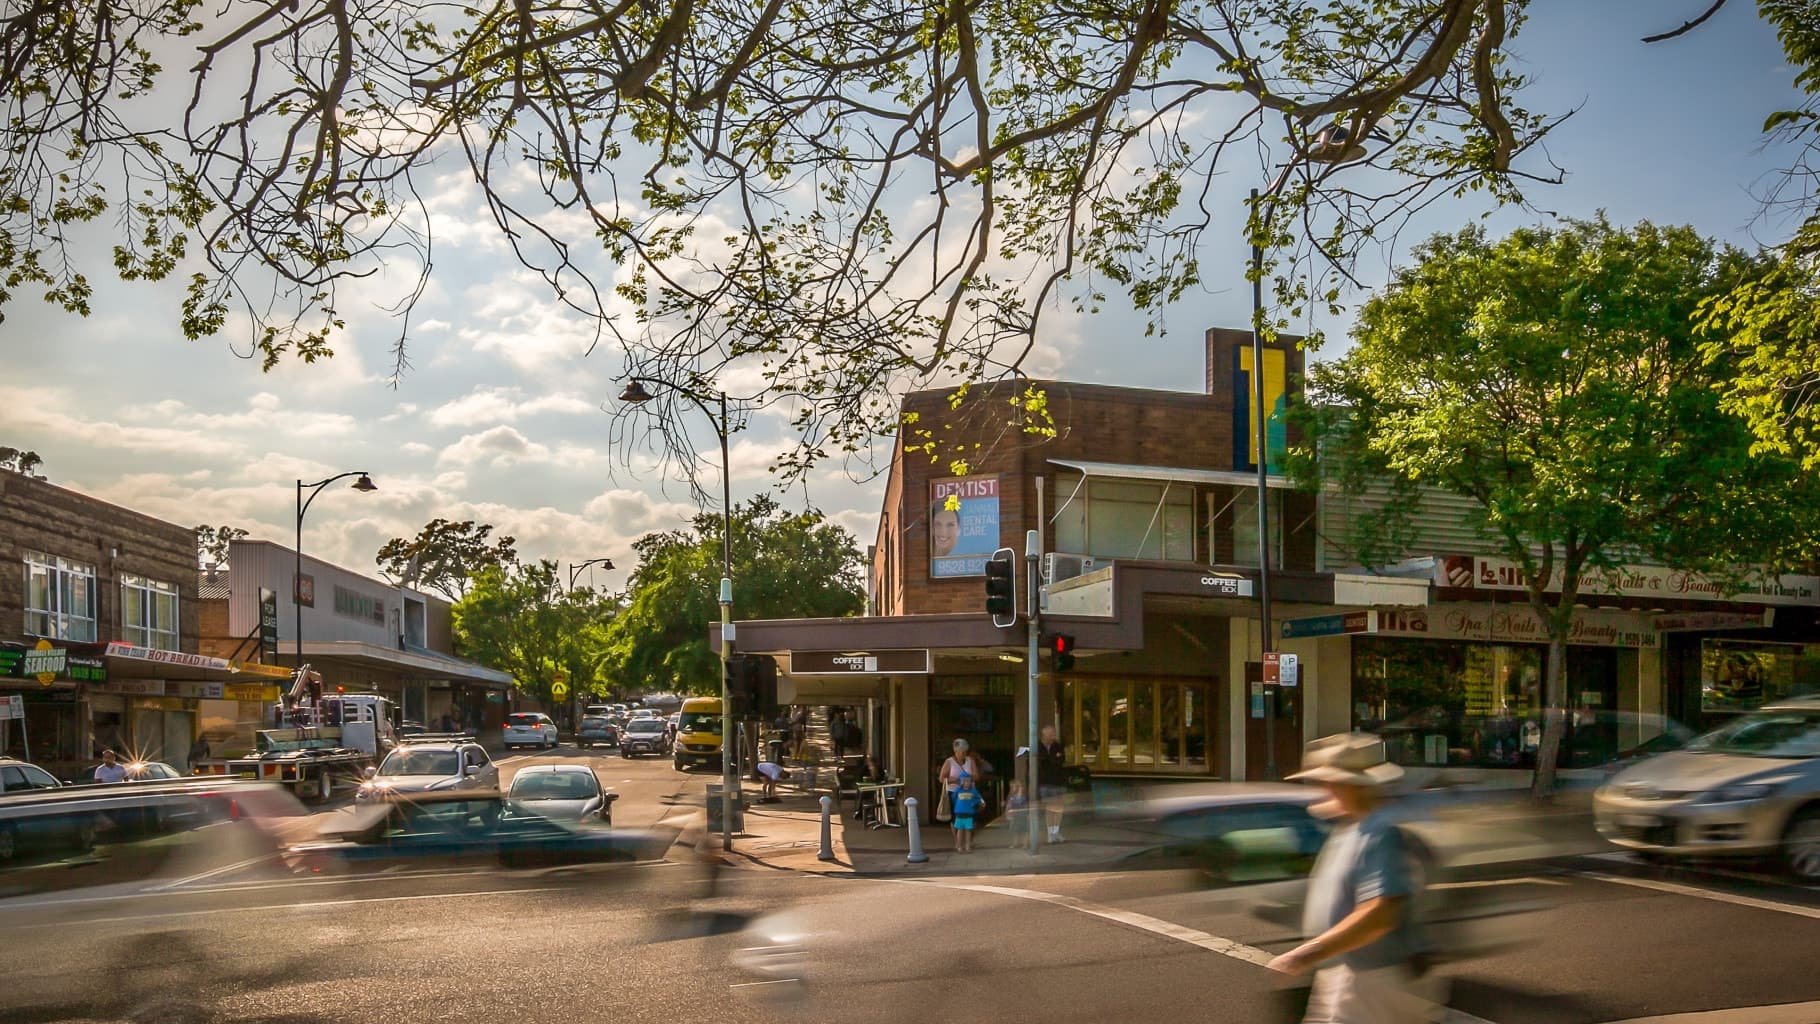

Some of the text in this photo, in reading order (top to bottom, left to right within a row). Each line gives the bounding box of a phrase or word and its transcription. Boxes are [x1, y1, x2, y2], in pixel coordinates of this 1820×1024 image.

[936, 480, 996, 499] DENTIST
[963, 514, 997, 526] DENTAL
[963, 526, 986, 537] CARE
[938, 560, 966, 574] 9528
[1201, 577, 1237, 586] COFFEE
[1649, 576, 1662, 590] &
[265, 603, 274, 615] FOR
[1446, 611, 1482, 637] Spa
[1489, 613, 1535, 634] Nails
[1569, 619, 1617, 643] Beauty
[24, 656, 66, 674] SEAFOOD
[148, 650, 169, 661] HOT
[170, 653, 200, 666] BREAD
